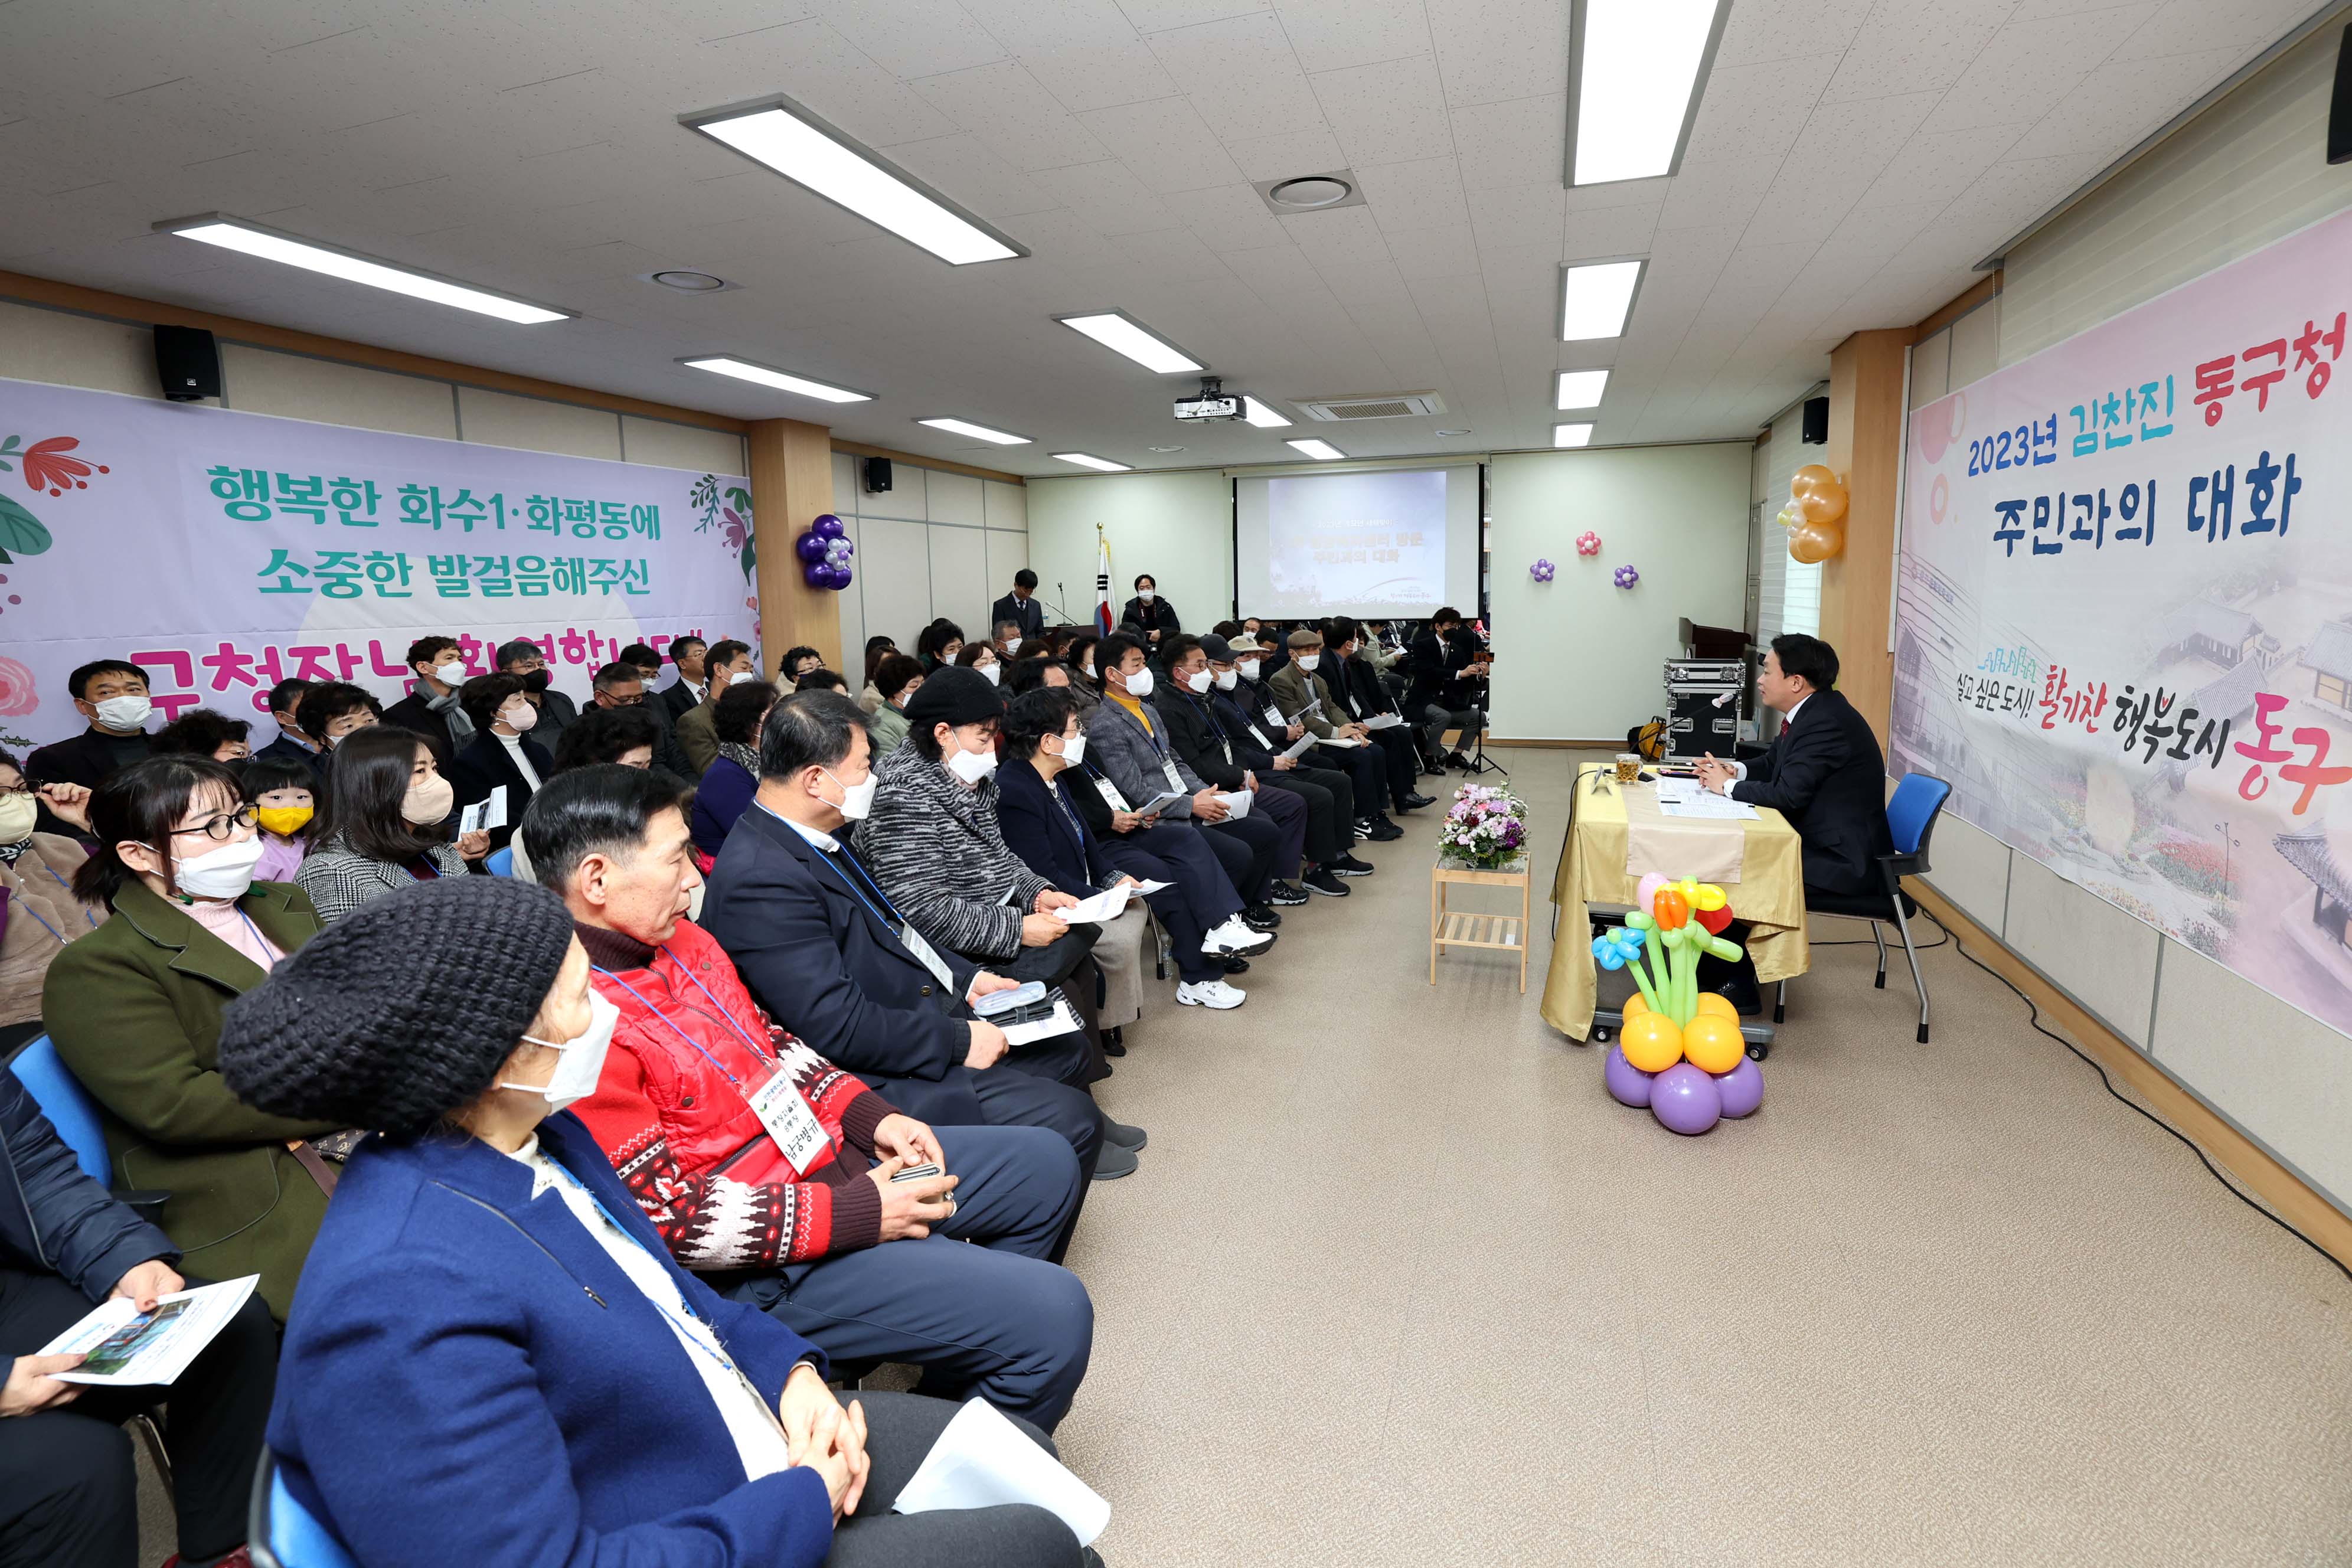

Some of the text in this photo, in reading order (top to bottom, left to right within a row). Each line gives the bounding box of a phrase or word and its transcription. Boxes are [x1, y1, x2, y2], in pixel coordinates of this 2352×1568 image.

[1968, 312, 2347, 476] 2023년 김찬진 동구청
[208, 465, 661, 541] 행복한 화수1·화평동에
[1993, 451, 2302, 557] 주민과의 대화
[258, 550, 650, 599] 소중한 발걸음해주신
[1957, 664, 2352, 815] 살고 싶은 도시! 활기찬 행복도시 동구
[785, 1118, 819, 1160] 남궁병규
